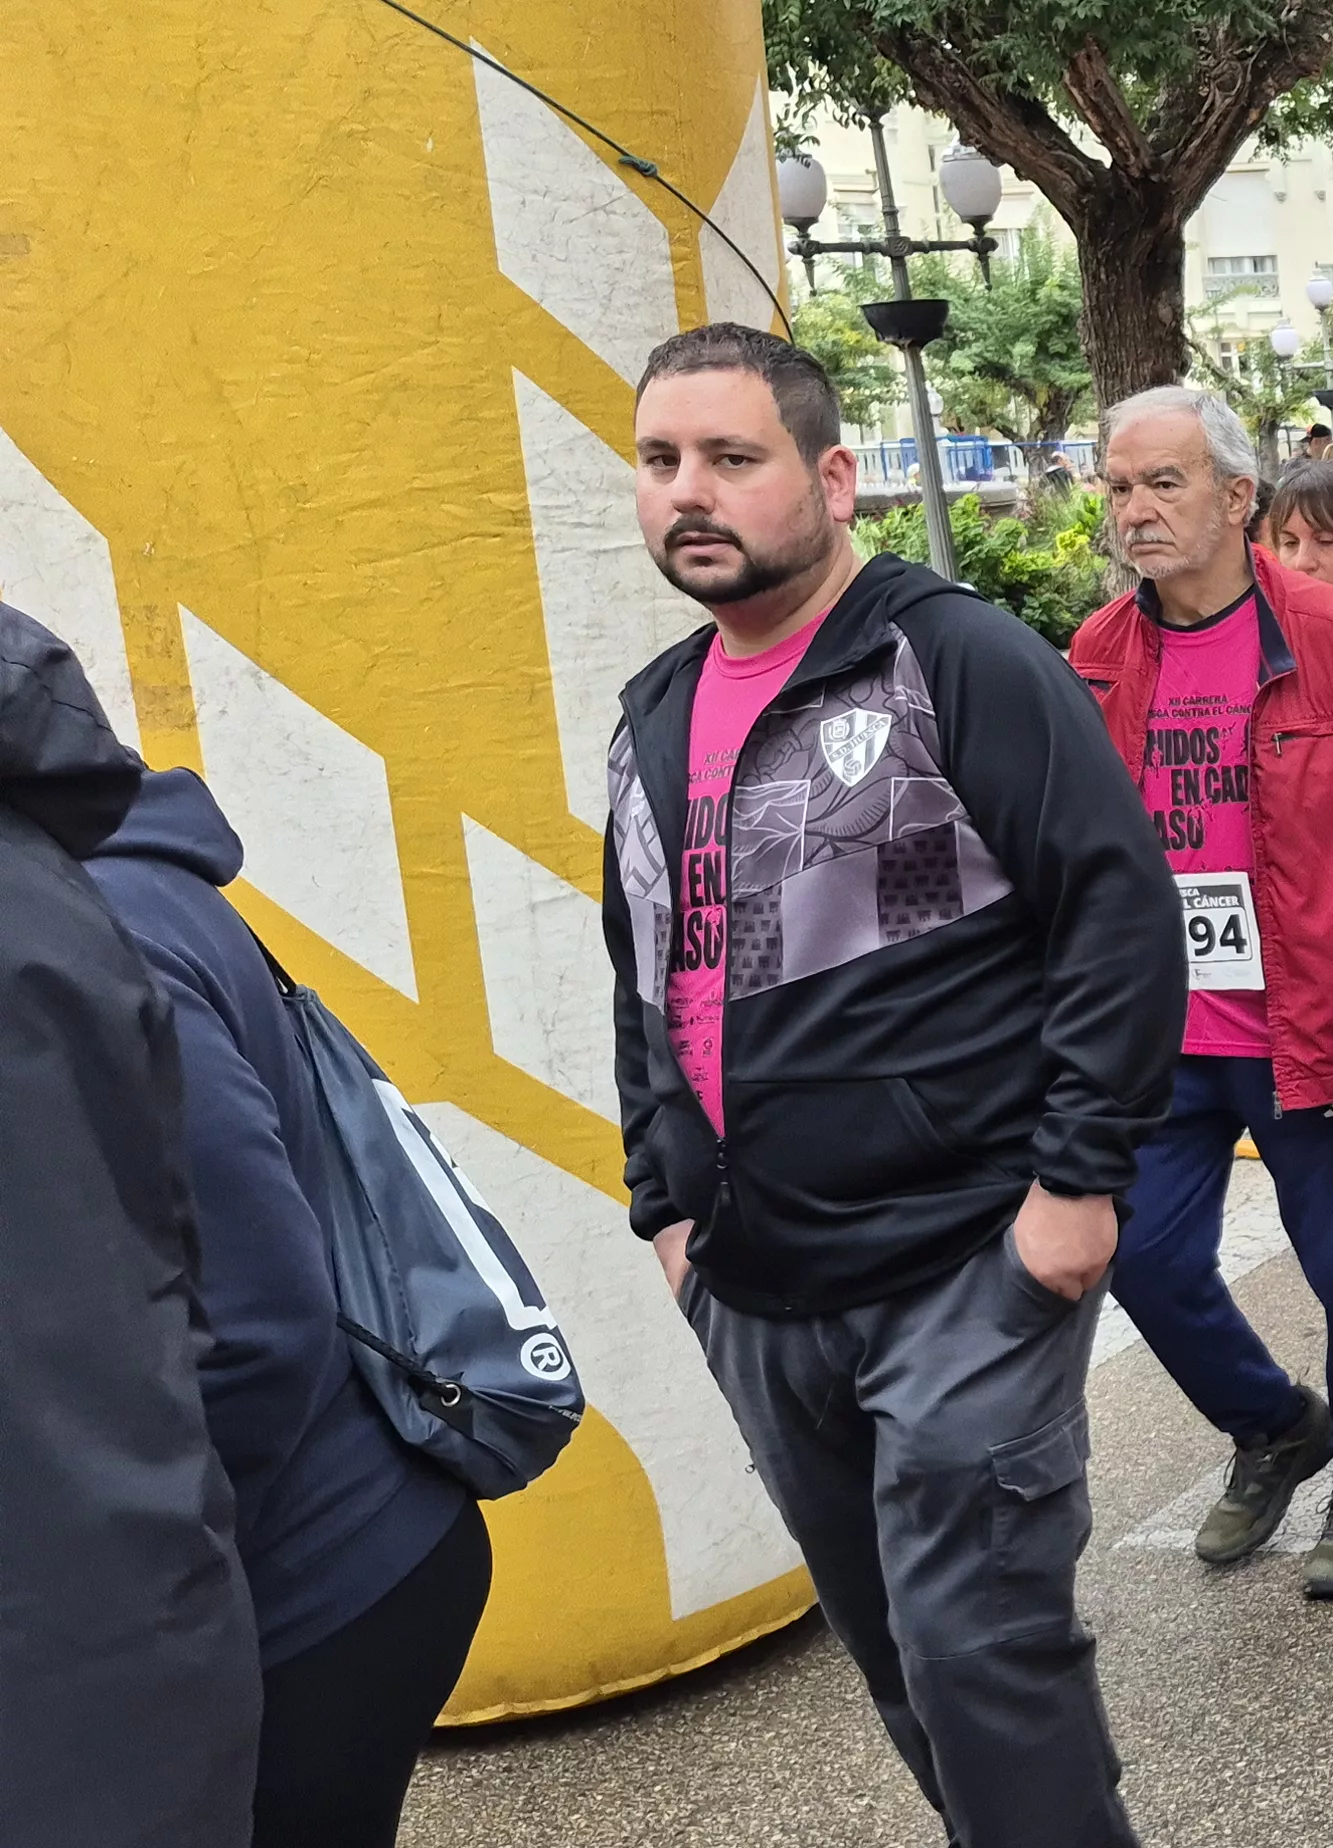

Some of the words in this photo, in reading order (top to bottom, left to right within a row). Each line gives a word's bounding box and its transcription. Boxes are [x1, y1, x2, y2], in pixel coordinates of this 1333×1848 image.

[1183, 695, 1228, 706] CARRERA
[1172, 707, 1211, 718] CONTRA
[849, 718, 888, 750] HUESCA
[1171, 768, 1201, 806] EN
[689, 850, 726, 906] EN
[1193, 895, 1240, 909] CÁNCER
